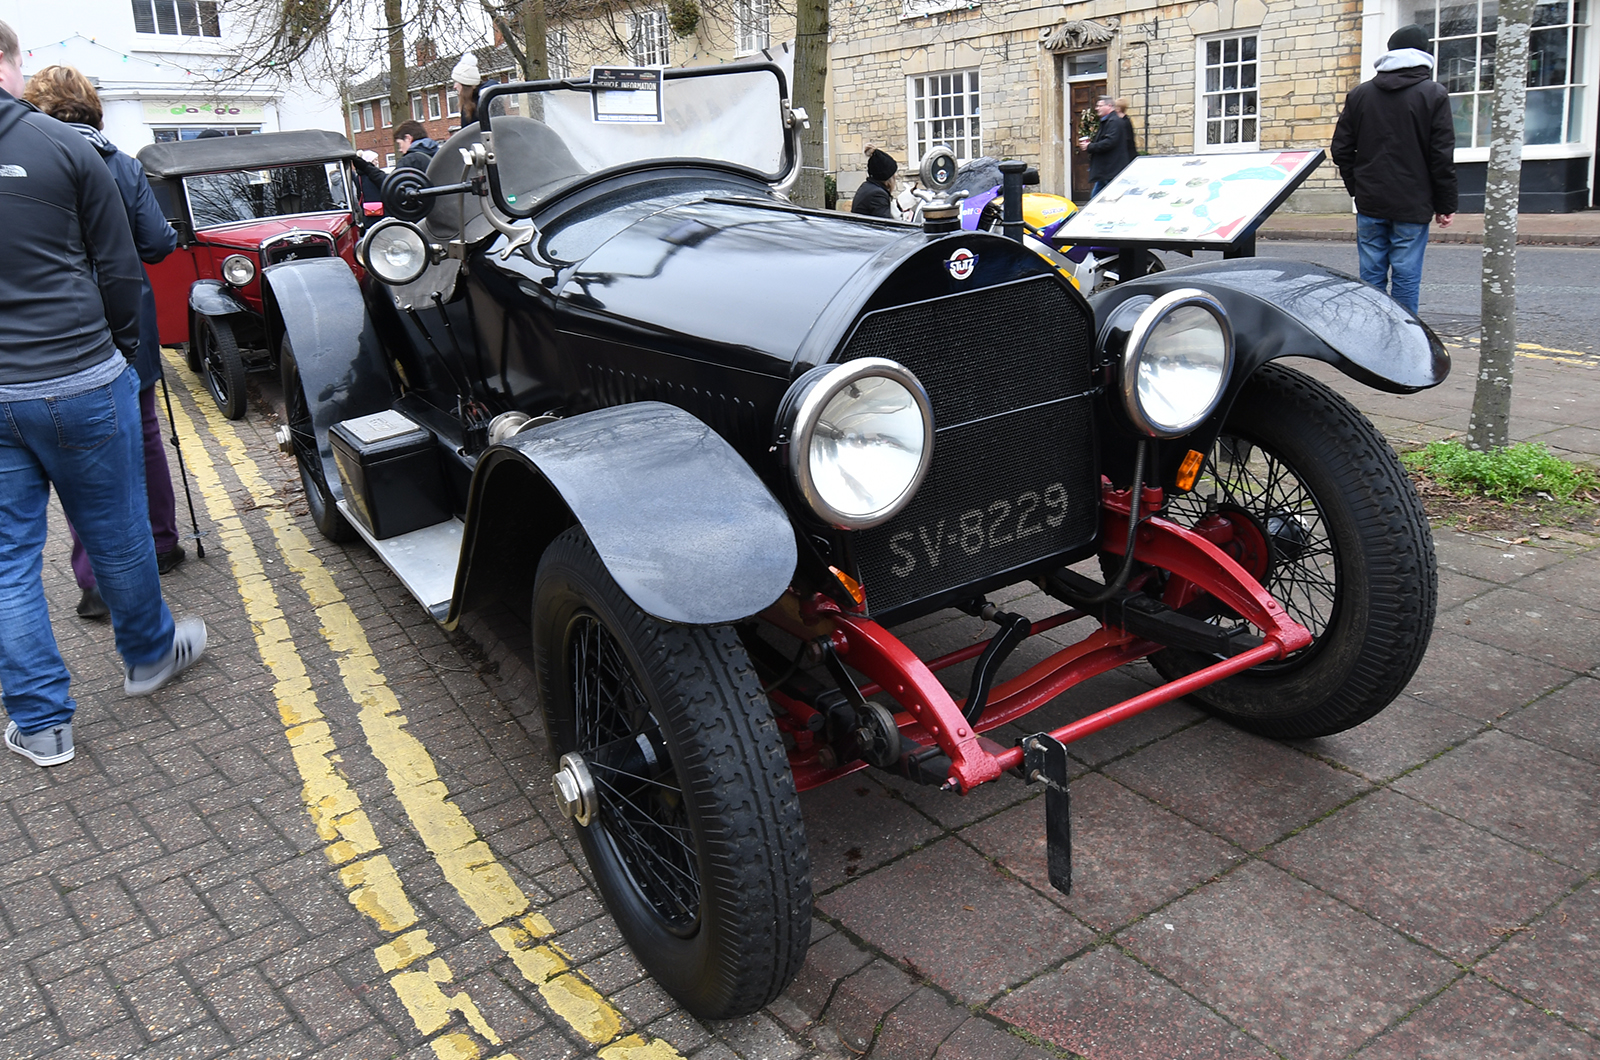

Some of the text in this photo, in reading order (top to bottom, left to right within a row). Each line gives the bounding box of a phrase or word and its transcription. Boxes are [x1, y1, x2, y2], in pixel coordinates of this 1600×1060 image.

[621, 82, 656, 90] INFORMATION
[950, 259, 975, 271] STUTZ
[889, 482, 1069, 578] SV-8229
